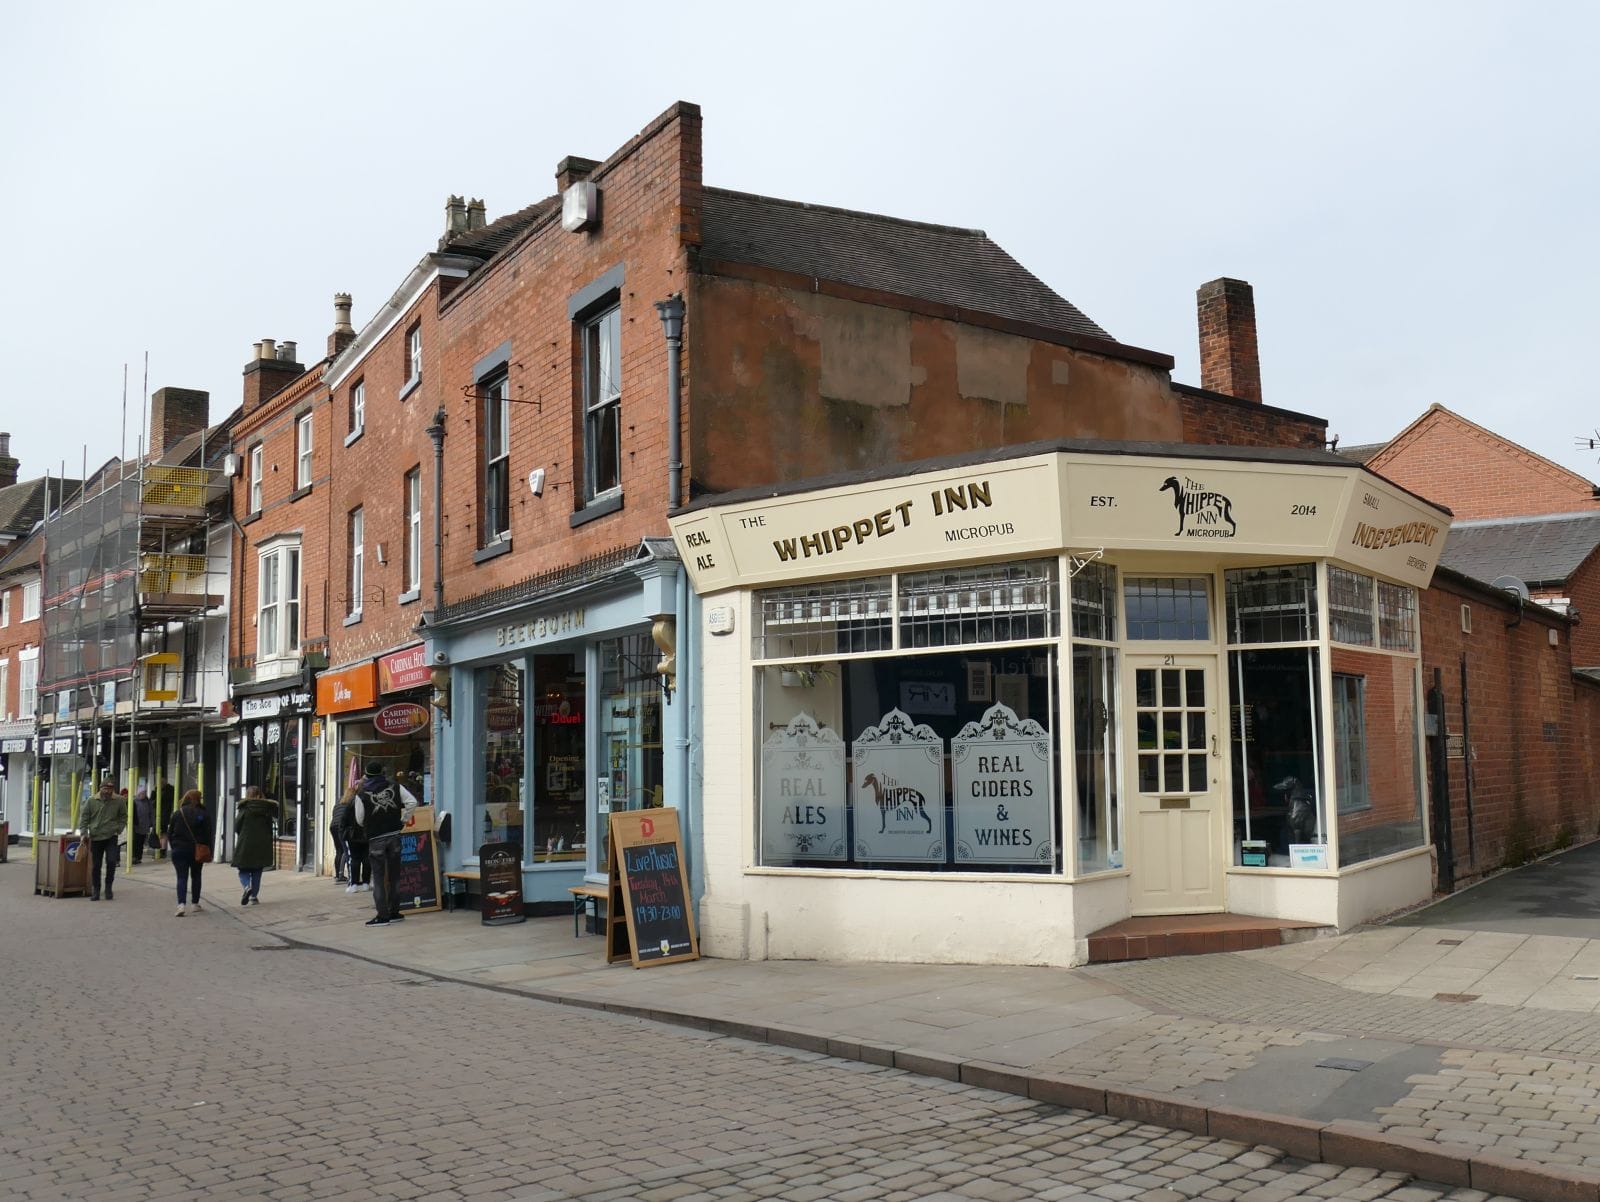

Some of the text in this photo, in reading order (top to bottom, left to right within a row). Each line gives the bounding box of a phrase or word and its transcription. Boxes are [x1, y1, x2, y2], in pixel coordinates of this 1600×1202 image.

[1184, 477, 1205, 491] THE
[1090, 495, 1118, 508] EST.
[1362, 492, 1380, 510] SMALL
[1196, 511, 1218, 525] INN
[1290, 504, 1317, 516] 2014
[739, 515, 767, 529] THE
[772, 480, 993, 562] WHIPPET INN
[685, 530, 711, 549] REAL
[944, 522, 1015, 543] MICROPUB
[1186, 529, 1231, 538] MICROPUB
[1351, 521, 1440, 550] INDEPENDENT
[696, 554, 716, 571] ALE
[496, 608, 586, 647] BEERBOHM
[390, 651, 425, 674] CARDINAL HOU
[1164, 655, 1175, 666] 21
[382, 707, 419, 719] CARDINAL
[551, 712, 581, 724] Duvel
[384, 717, 409, 727] HOUSE
[978, 756, 1024, 773] REAL
[780, 778, 826, 797] REAL
[971, 779, 1034, 798] CIDERS
[782, 806, 826, 825] ALES
[896, 808, 914, 821] INN
[996, 805, 1009, 821] &
[975, 829, 1033, 846] WINES
[626, 851, 650, 872] Live
